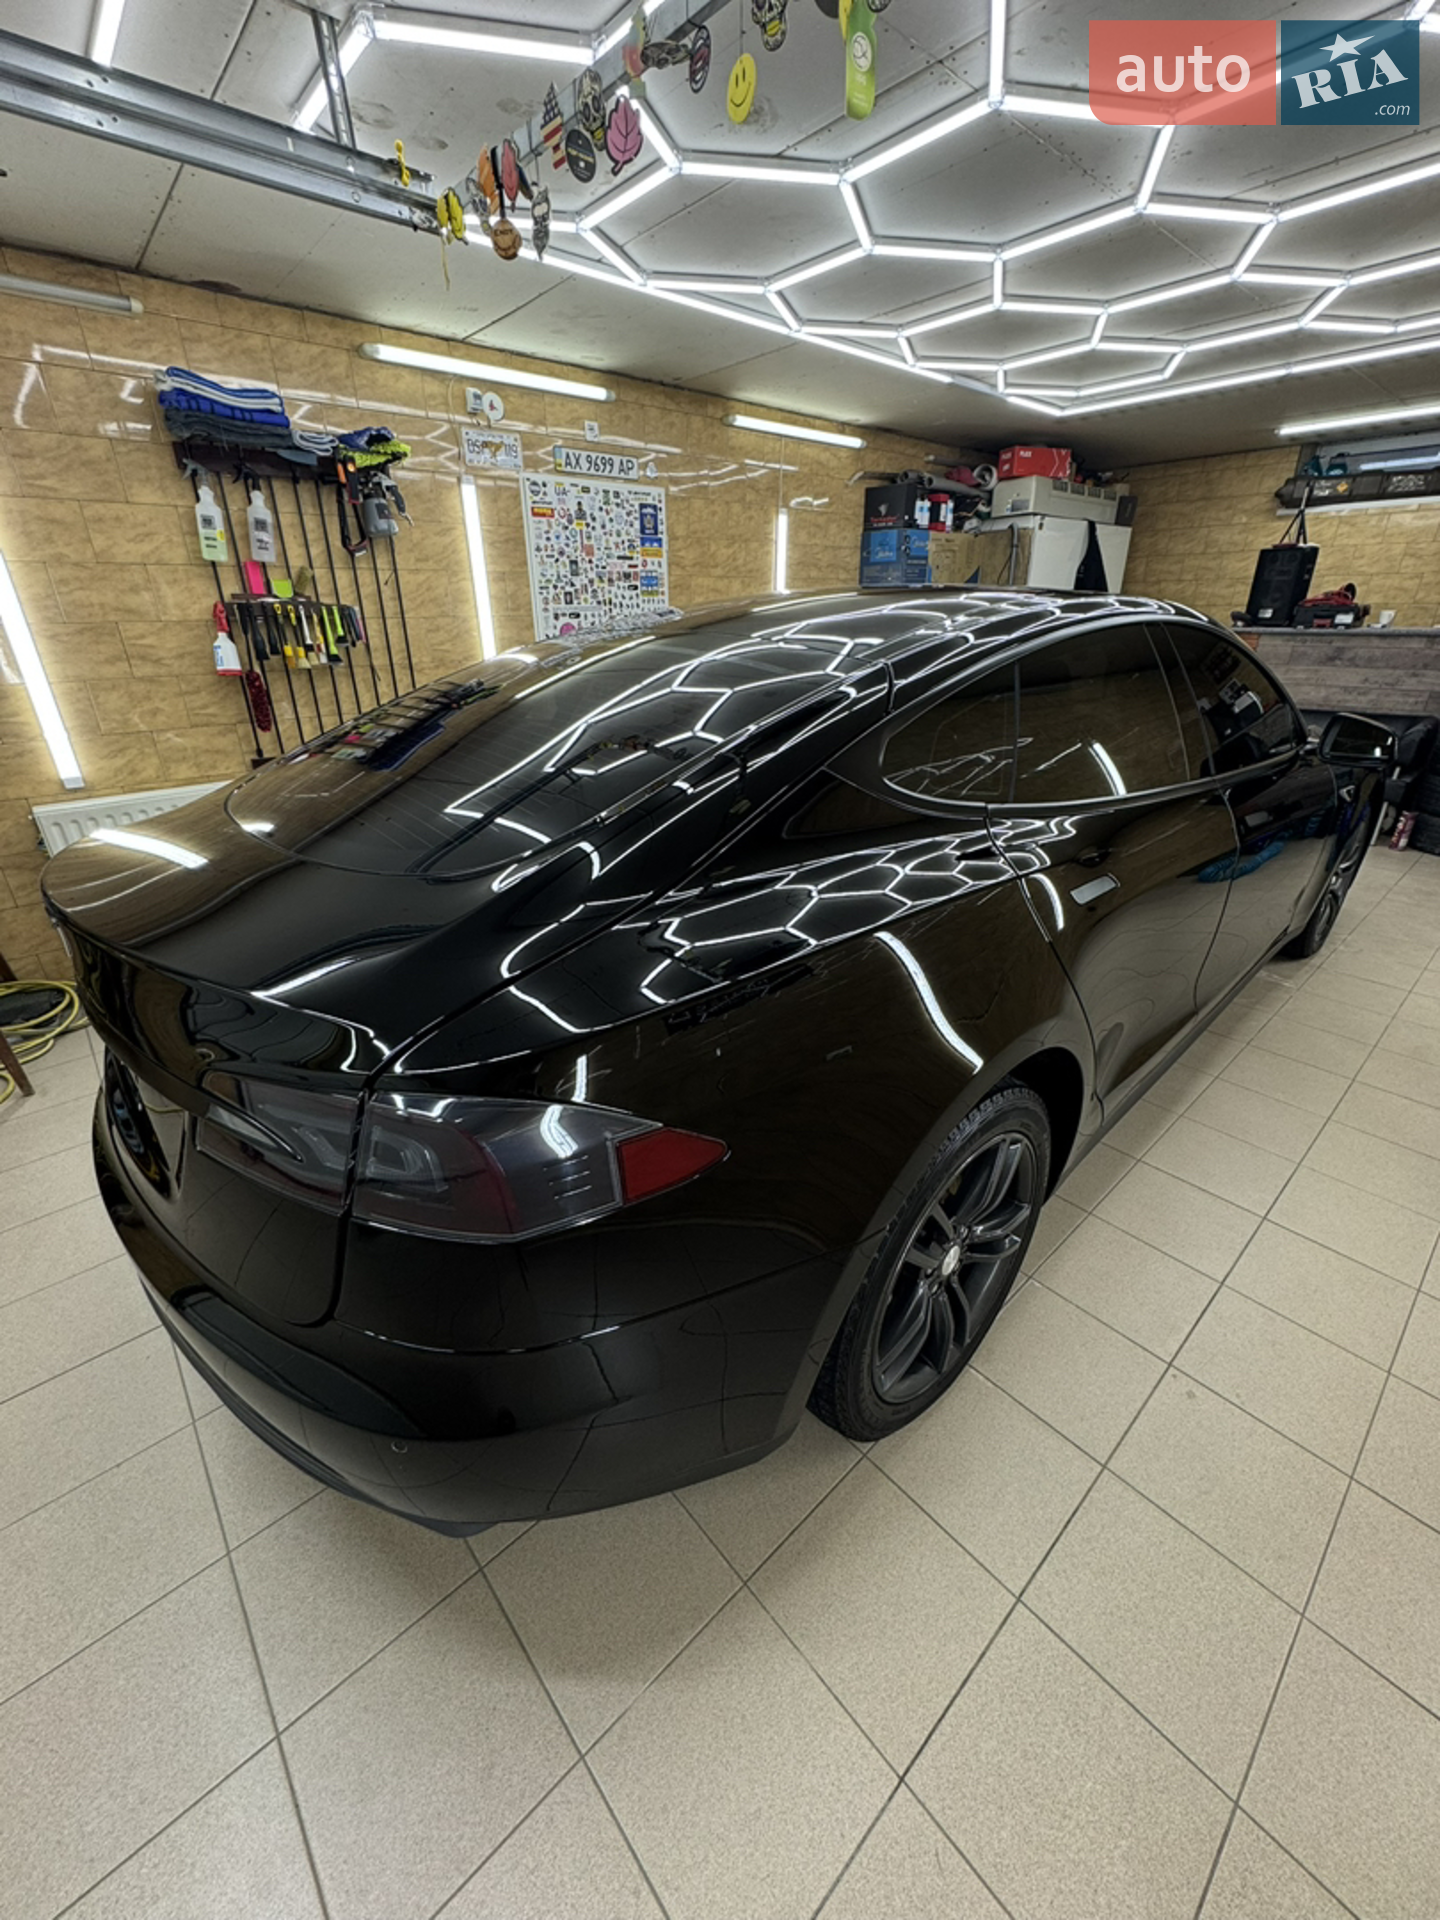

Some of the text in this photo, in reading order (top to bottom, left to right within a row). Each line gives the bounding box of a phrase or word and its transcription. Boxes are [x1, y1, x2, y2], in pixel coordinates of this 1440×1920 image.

[564, 451, 635, 476] AX 9699 AP
